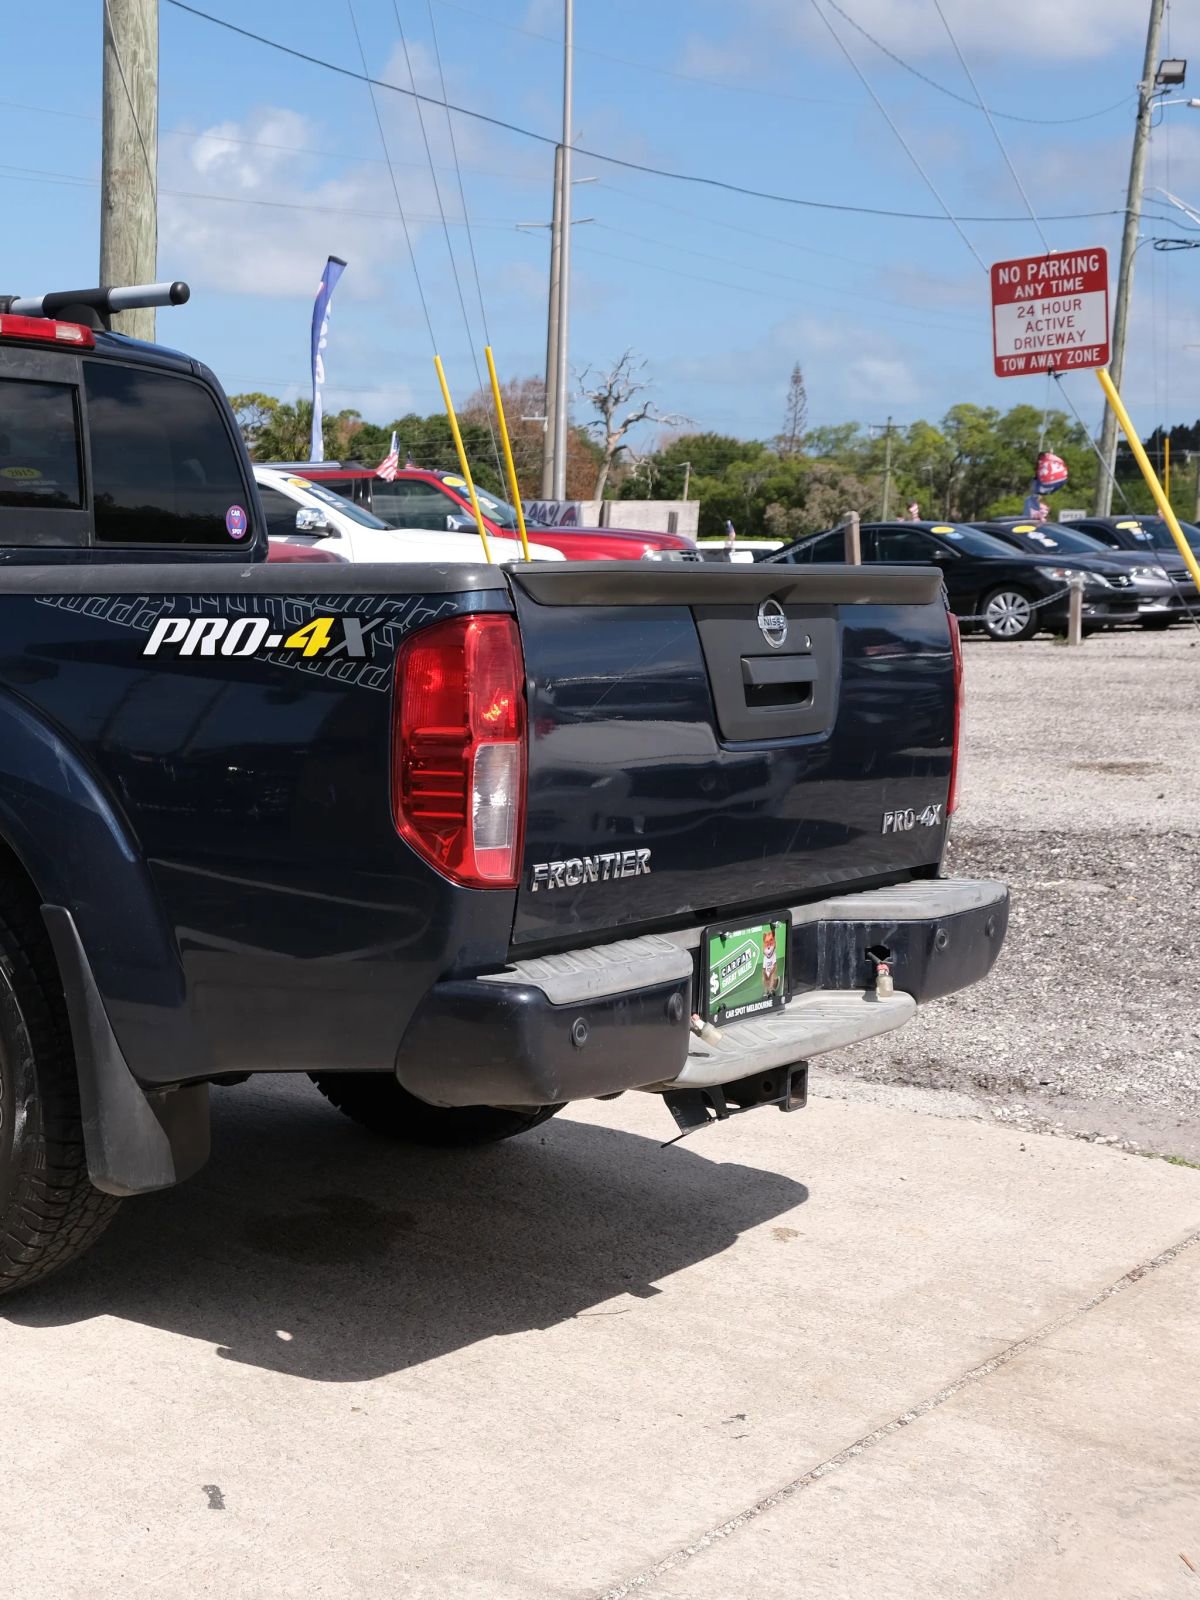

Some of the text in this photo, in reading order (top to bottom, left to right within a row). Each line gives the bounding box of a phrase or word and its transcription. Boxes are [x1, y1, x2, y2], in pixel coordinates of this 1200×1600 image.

[999, 255, 1099, 285] NO PARKING
[1014, 277, 1084, 299] ANY TIME
[1017, 299, 1082, 319] 24 HOUR
[1025, 315, 1075, 333] ACTIVE
[1014, 330, 1086, 350] DRIVEWAY
[1002, 348, 1100, 372] TOW AWAY ZONE
[143, 617, 384, 657] PRO-4X
[881, 803, 942, 834] PRO-4X
[531, 848, 652, 892] FRONTIER
